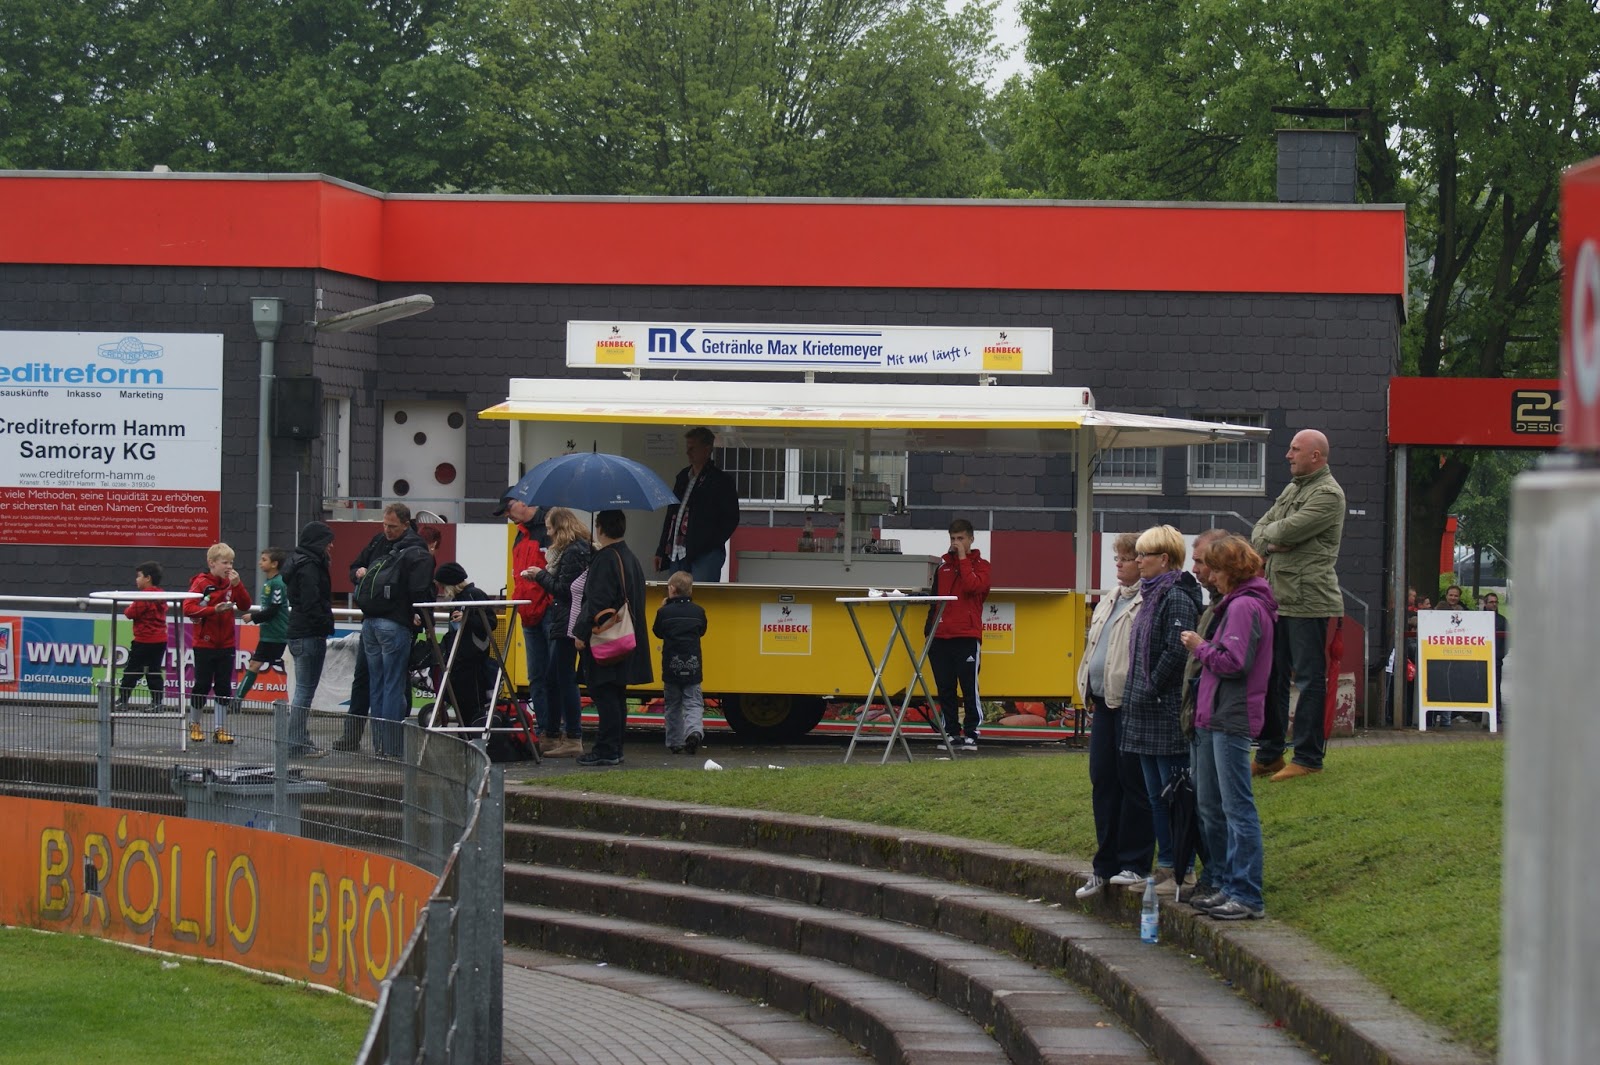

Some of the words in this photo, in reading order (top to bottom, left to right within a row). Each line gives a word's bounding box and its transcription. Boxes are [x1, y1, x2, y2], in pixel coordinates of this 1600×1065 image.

[702, 338, 763, 355] Getränke
[767, 340, 798, 356] Max
[803, 341, 883, 360] Krietemeyer
[984, 346, 1021, 354] ISENBECK
[887, 354, 905, 366] Mit
[908, 352, 928, 364] uns
[932, 346, 961, 362] läuft
[0, 389, 49, 398] sauskünfte
[67, 390, 102, 399] Inkasso
[119, 391, 164, 401] Marketing
[123, 420, 186, 437] Hamm
[20, 440, 116, 464] Samoray
[123, 442, 156, 460] KG
[19, 469, 156, 481] www.creditreform-hamm.de
[4, 490, 26, 499] viele
[28, 490, 78, 501] Methoden,
[80, 491, 104, 501] seine
[106, 491, 150, 502] Liquidität
[151, 494, 163, 502] zu
[165, 493, 207, 503] erhöhen.
[12, 501, 59, 511] sichersten
[60, 502, 76, 511] hat
[78, 502, 104, 512] einen
[106, 503, 143, 513] Namen:
[145, 503, 209, 514] Creditreform.
[763, 624, 808, 633] ISENBECK
[1428, 635, 1486, 646] ISENBECK
[24, 673, 94, 684] DIGITALDRUCK
[266, 683, 287, 692] RAU
[39, 814, 260, 954] BRÖLIO
